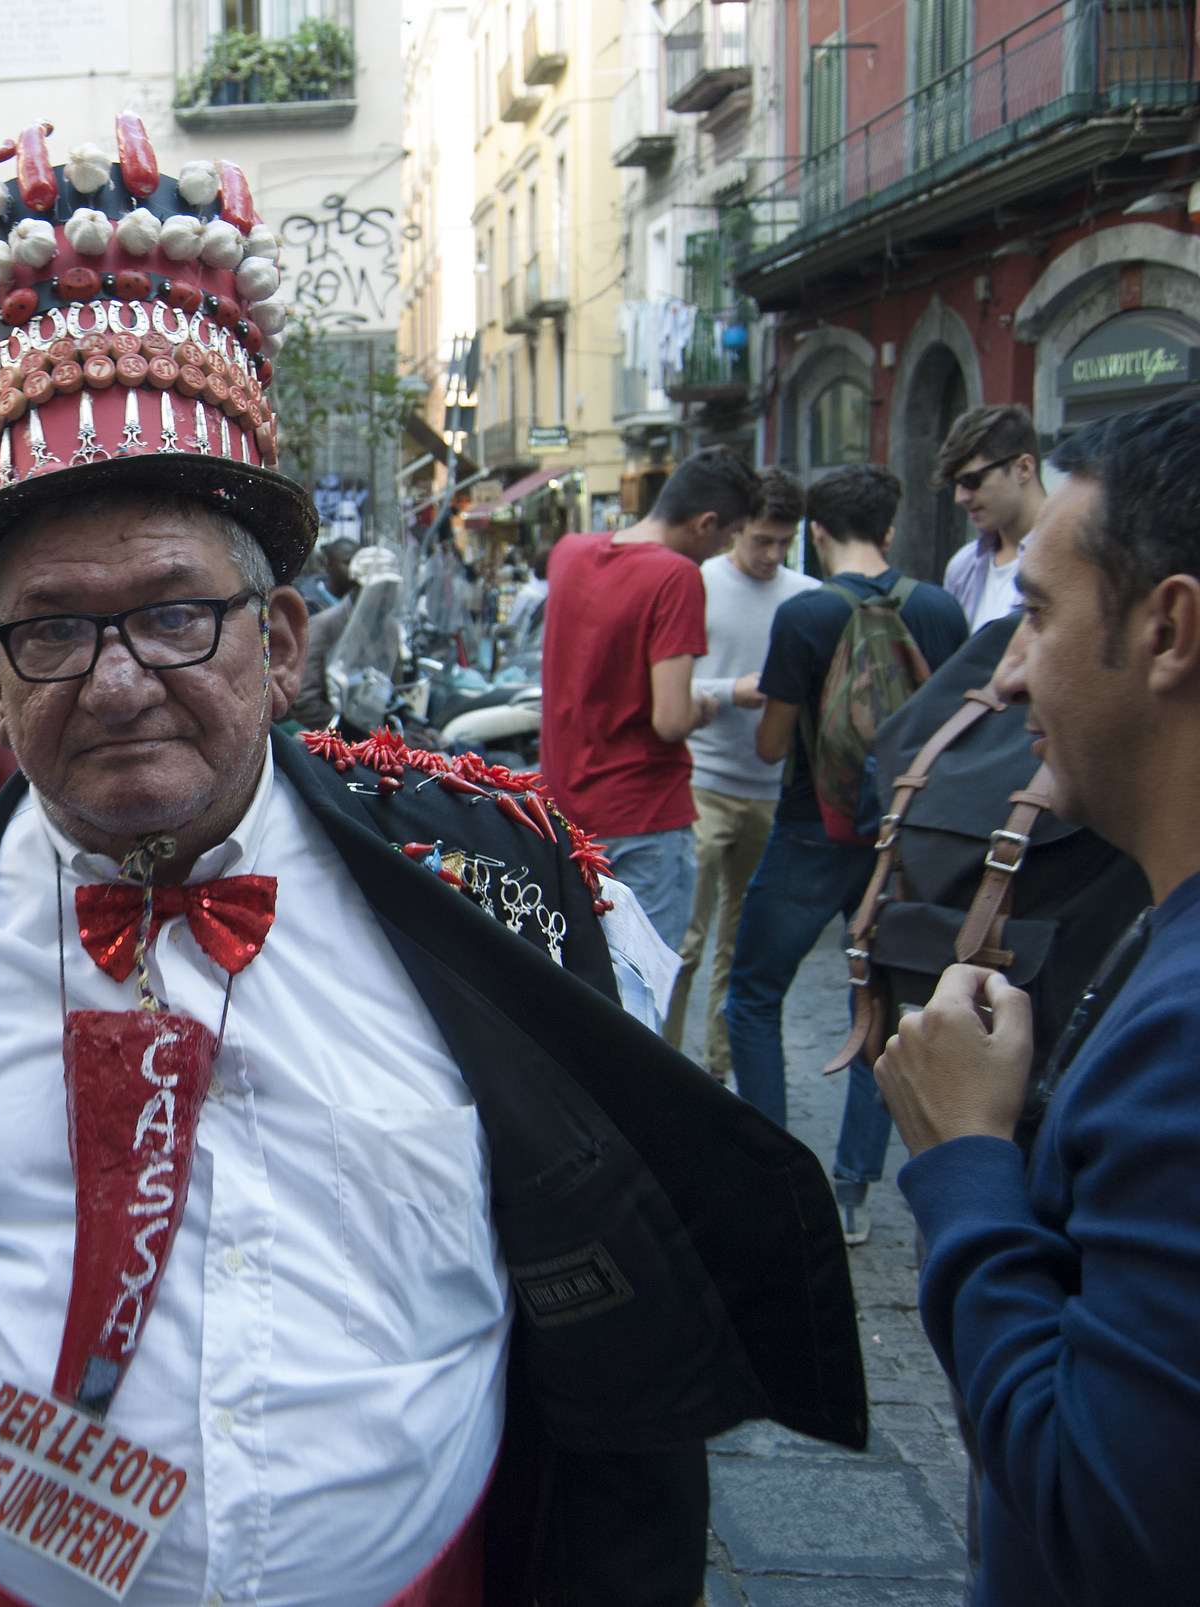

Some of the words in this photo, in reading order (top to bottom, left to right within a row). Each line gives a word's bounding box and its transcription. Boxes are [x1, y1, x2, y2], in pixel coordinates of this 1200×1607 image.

[92, 359, 107, 377] 7
[100, 1032, 179, 1355] CASSA
[44, 1412, 105, 1476] LE
[89, 1436, 187, 1518] FOTO
